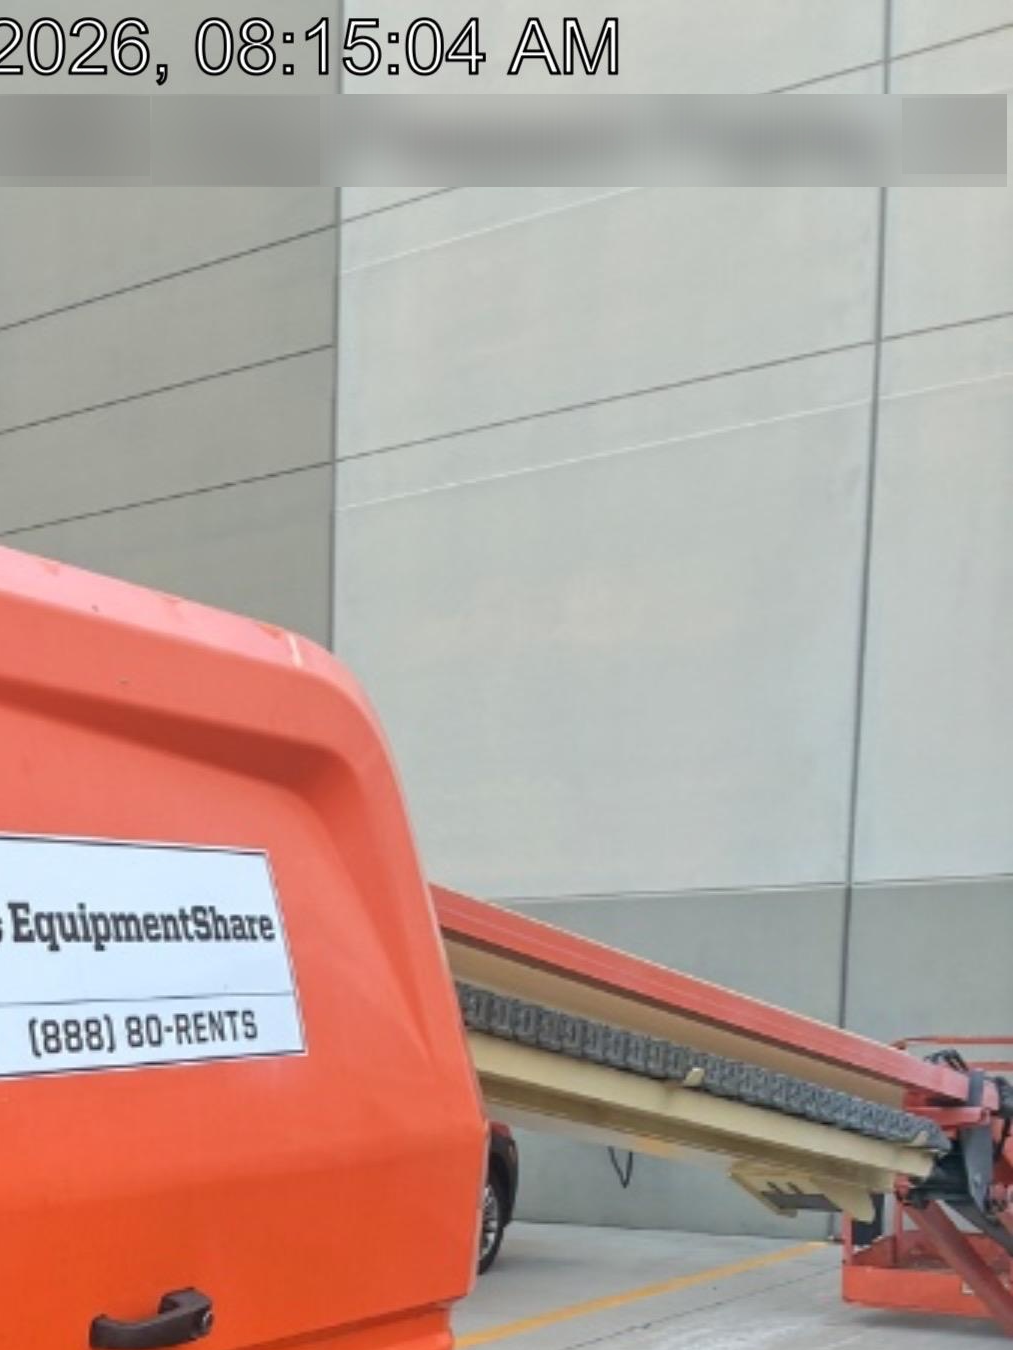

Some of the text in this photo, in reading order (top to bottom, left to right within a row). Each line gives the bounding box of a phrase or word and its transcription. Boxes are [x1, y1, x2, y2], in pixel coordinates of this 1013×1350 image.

[7, 902, 276, 951] EquipmentShare
[28, 1010, 258, 1057] (888) 80-RENTS
